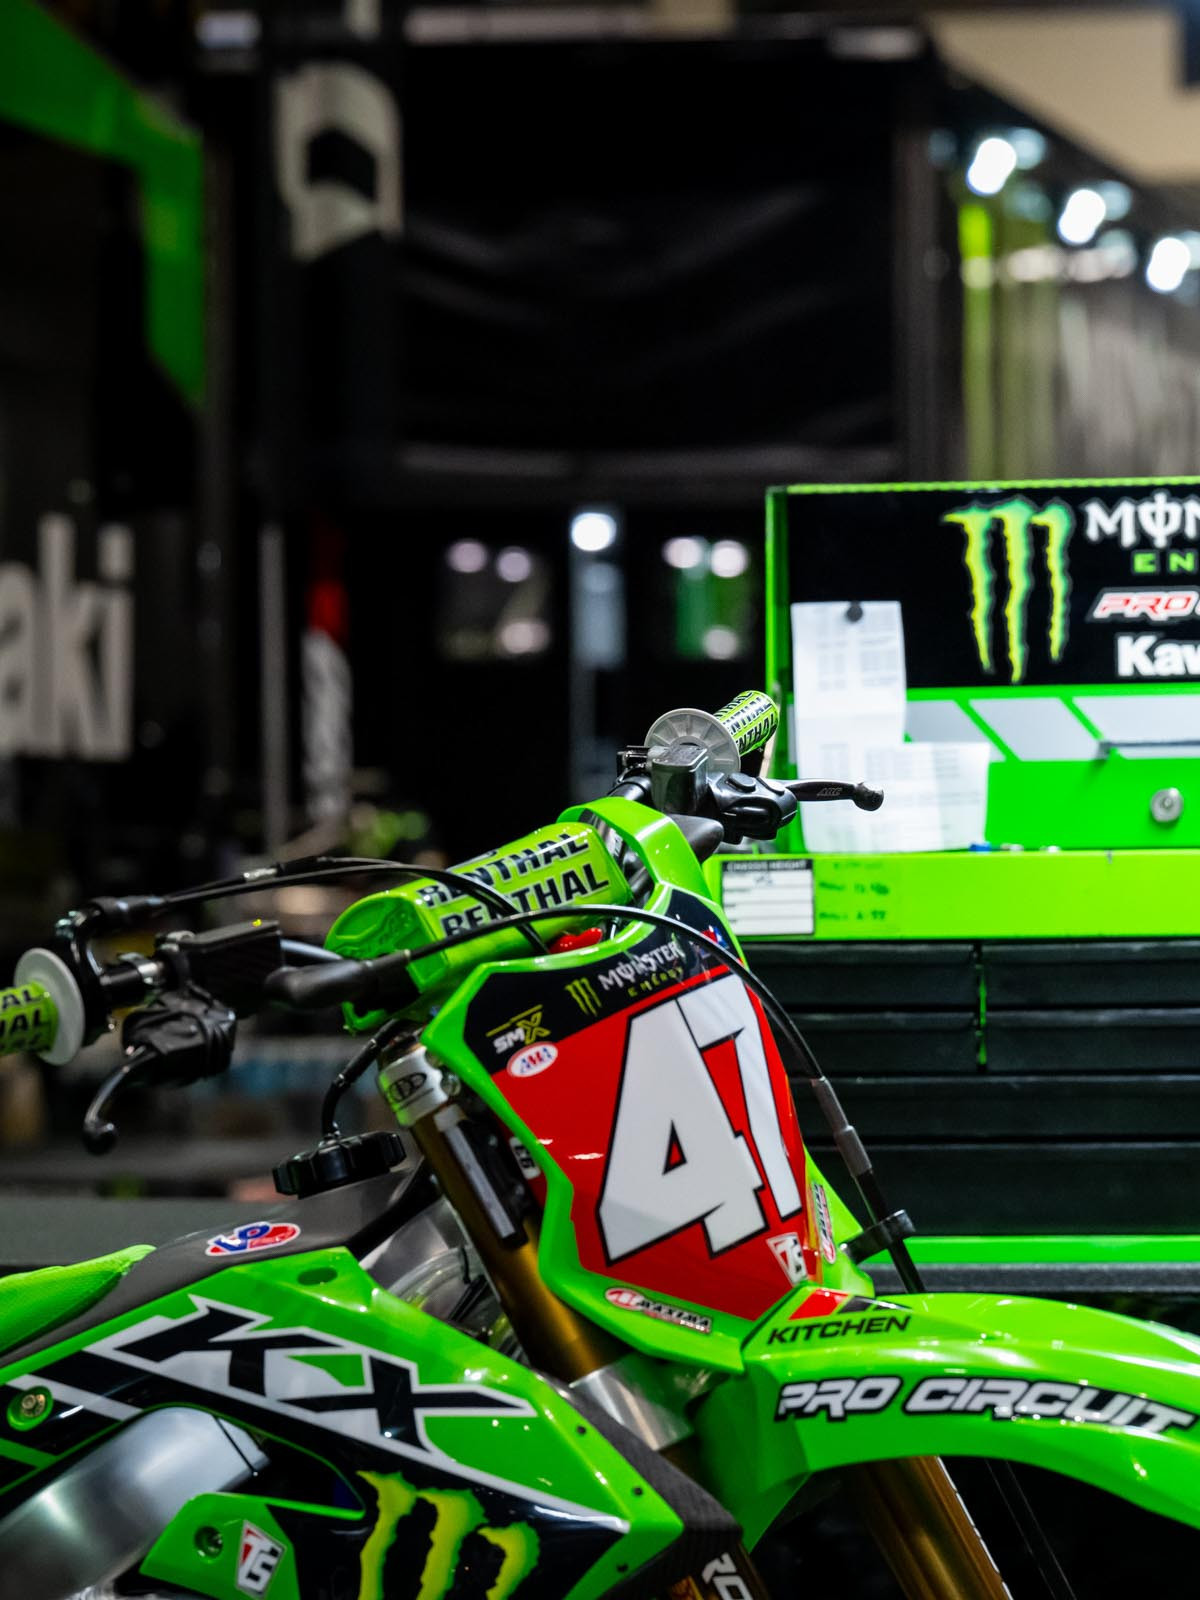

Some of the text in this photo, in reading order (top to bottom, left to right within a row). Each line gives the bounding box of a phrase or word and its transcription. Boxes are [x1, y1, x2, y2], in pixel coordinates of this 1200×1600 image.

[1093, 589, 1200, 621] PRO
[597, 940, 686, 991] MONSTER
[493, 1012, 551, 1054] SMX
[595, 972, 803, 1268] 47
[767, 1315, 912, 1345] KITCHEN
[98, 1298, 532, 1456] KX
[777, 1377, 1197, 1434] PRO CIRCUIT
